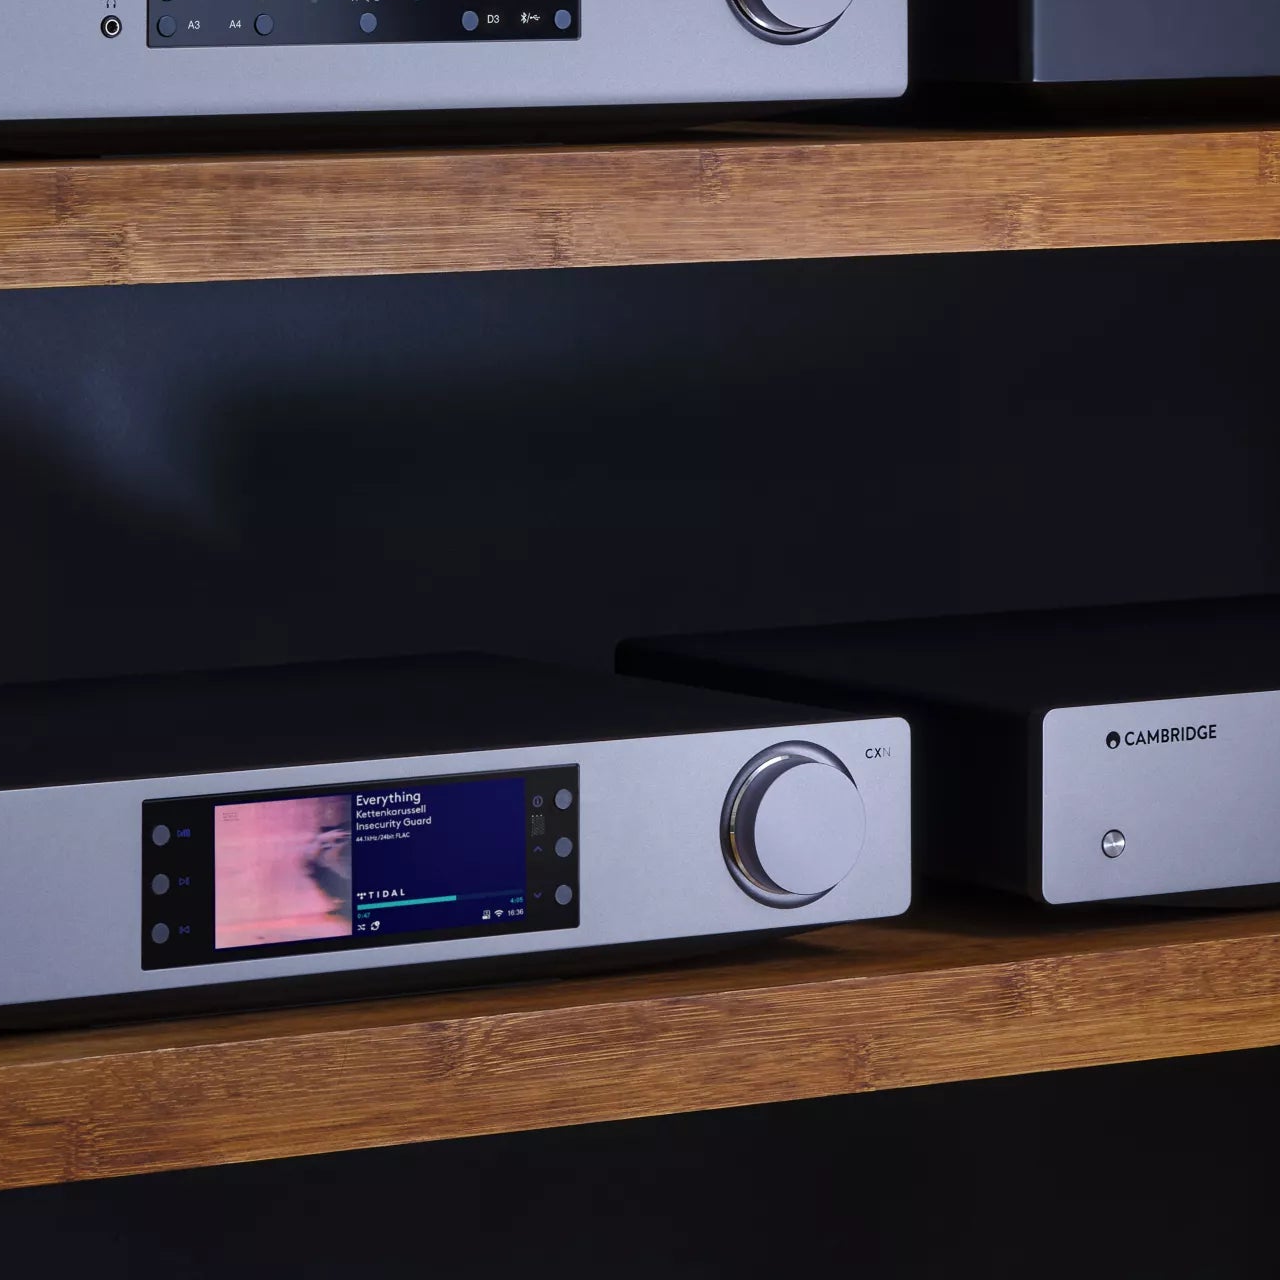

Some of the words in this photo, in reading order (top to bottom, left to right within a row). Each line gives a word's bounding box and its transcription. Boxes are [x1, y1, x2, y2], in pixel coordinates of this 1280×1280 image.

[187, 20, 201, 30] A3
[228, 19, 242, 29] A4
[487, 14, 500, 24] D3
[1124, 724, 1217, 746] CAMBRIDGE
[865, 746, 891, 759] CXN
[356, 791, 421, 807] Everything
[356, 804, 427, 819] Kettenkarussell
[356, 819, 401, 831] Insecurity
[402, 816, 432, 827] Guard
[369, 888, 406, 899] TIDAL
